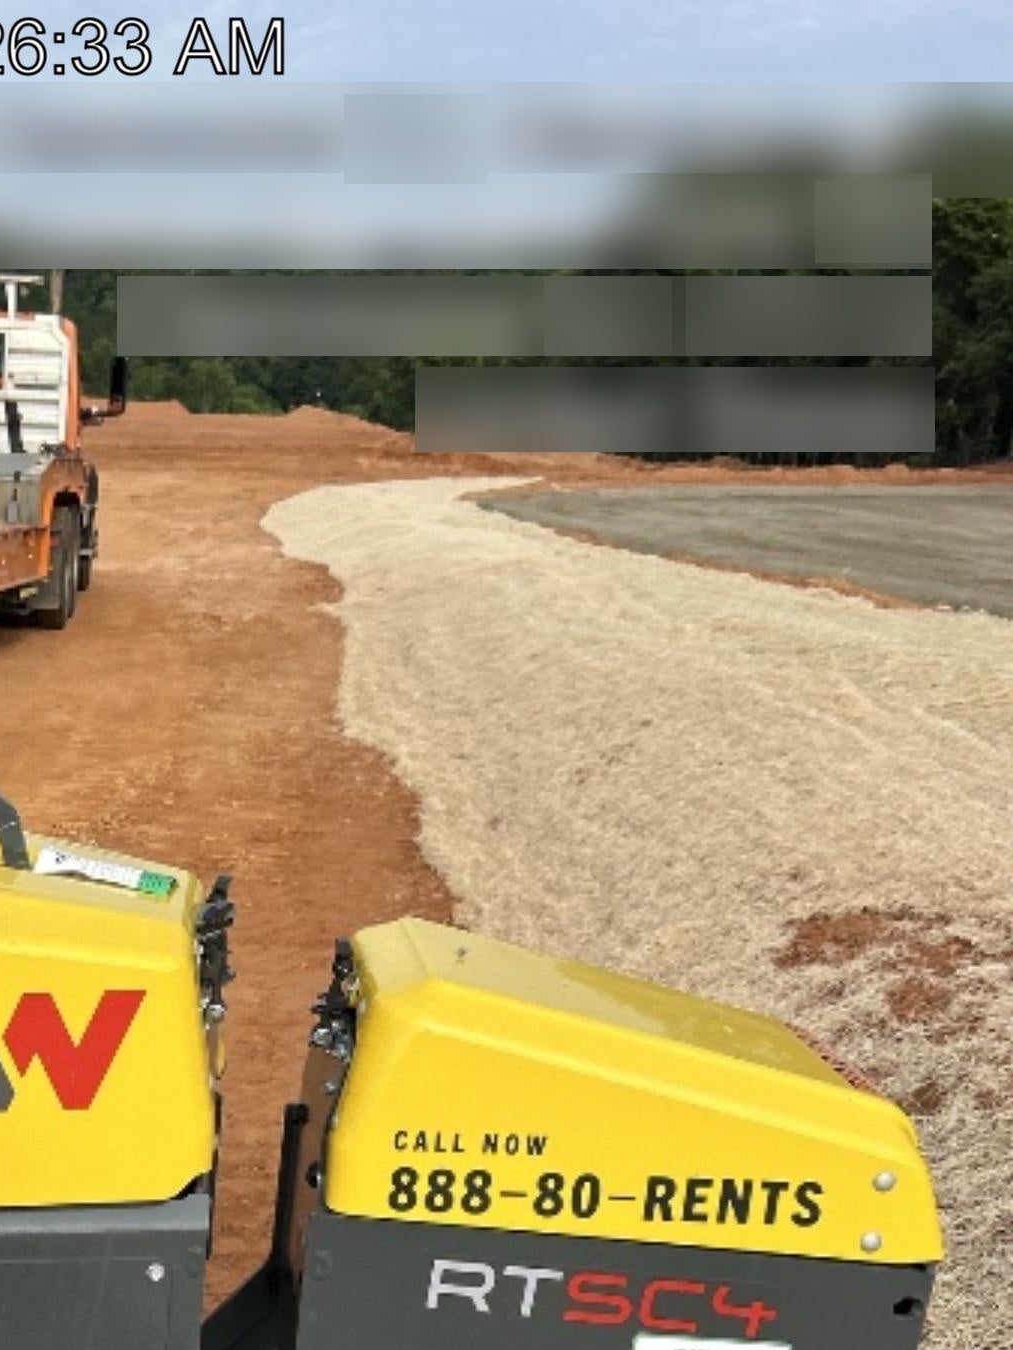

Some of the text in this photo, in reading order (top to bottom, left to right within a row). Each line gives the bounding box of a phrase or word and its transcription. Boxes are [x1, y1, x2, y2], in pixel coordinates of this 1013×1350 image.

[393, 1130, 549, 1157] CALL NOW
[387, 1166, 824, 1228] 888-80-RENTS
